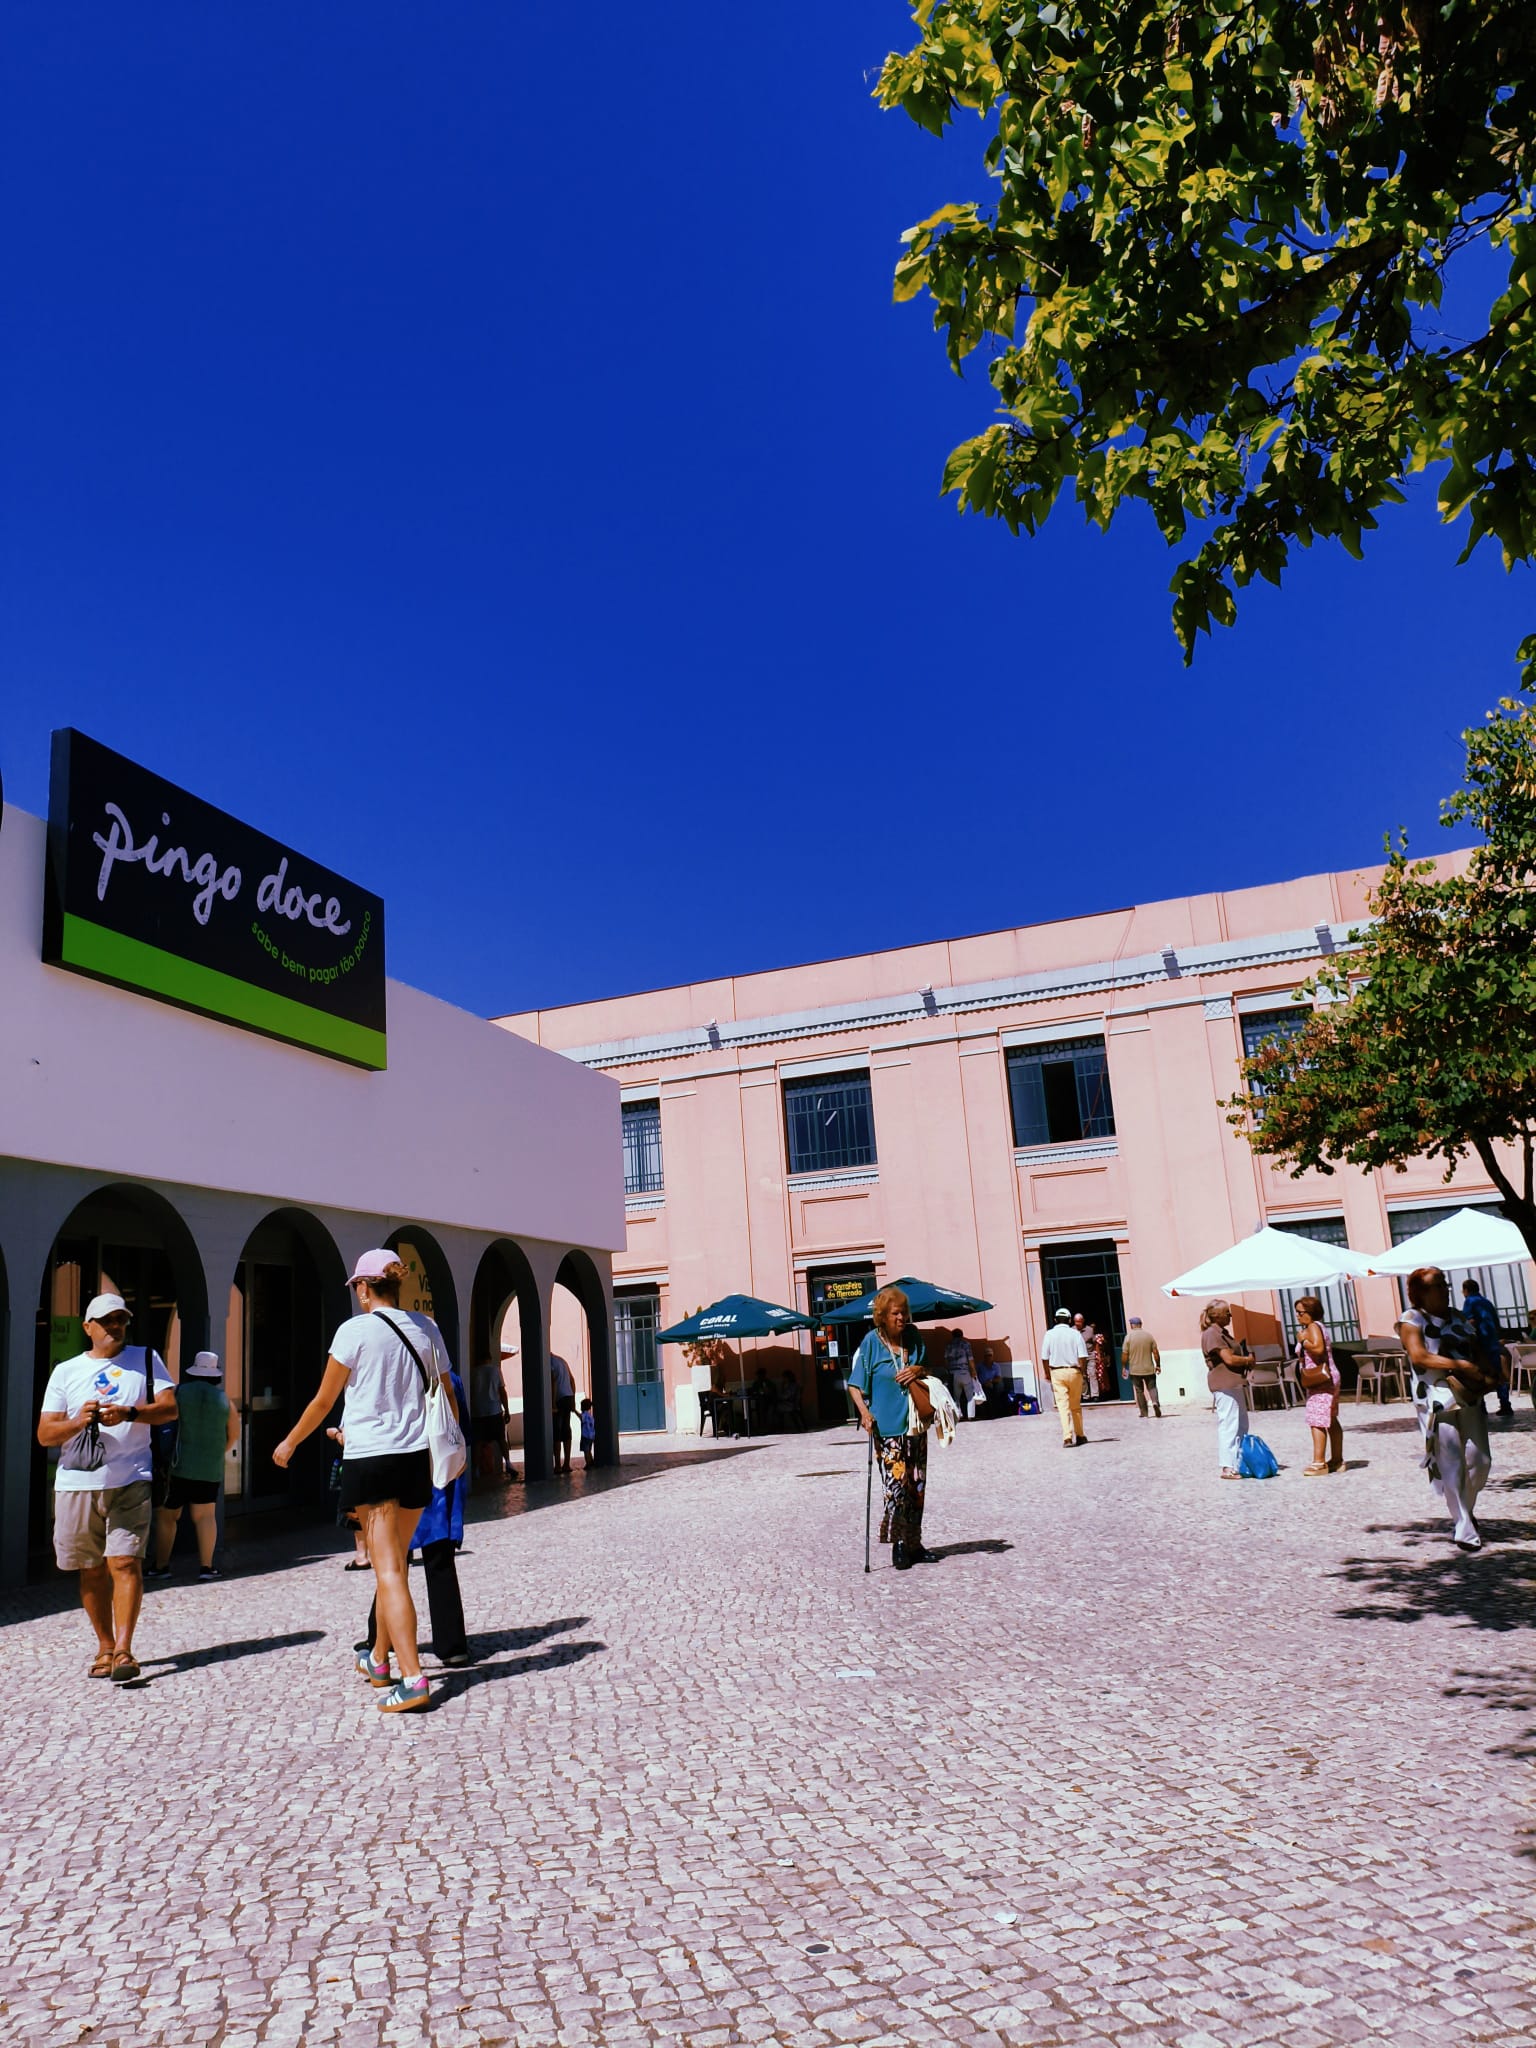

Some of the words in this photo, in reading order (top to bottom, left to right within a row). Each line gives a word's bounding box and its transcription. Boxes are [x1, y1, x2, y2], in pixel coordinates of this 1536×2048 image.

[93, 802, 242, 925] pingo
[257, 857, 352, 936] doce
[251, 922, 279, 959] sabe
[281, 951, 307, 979] bem
[309, 965, 339, 985] pagar
[340, 953, 356, 975] tão
[354, 910, 371, 961] pouco
[699, 1314, 738, 1326] CORAL
